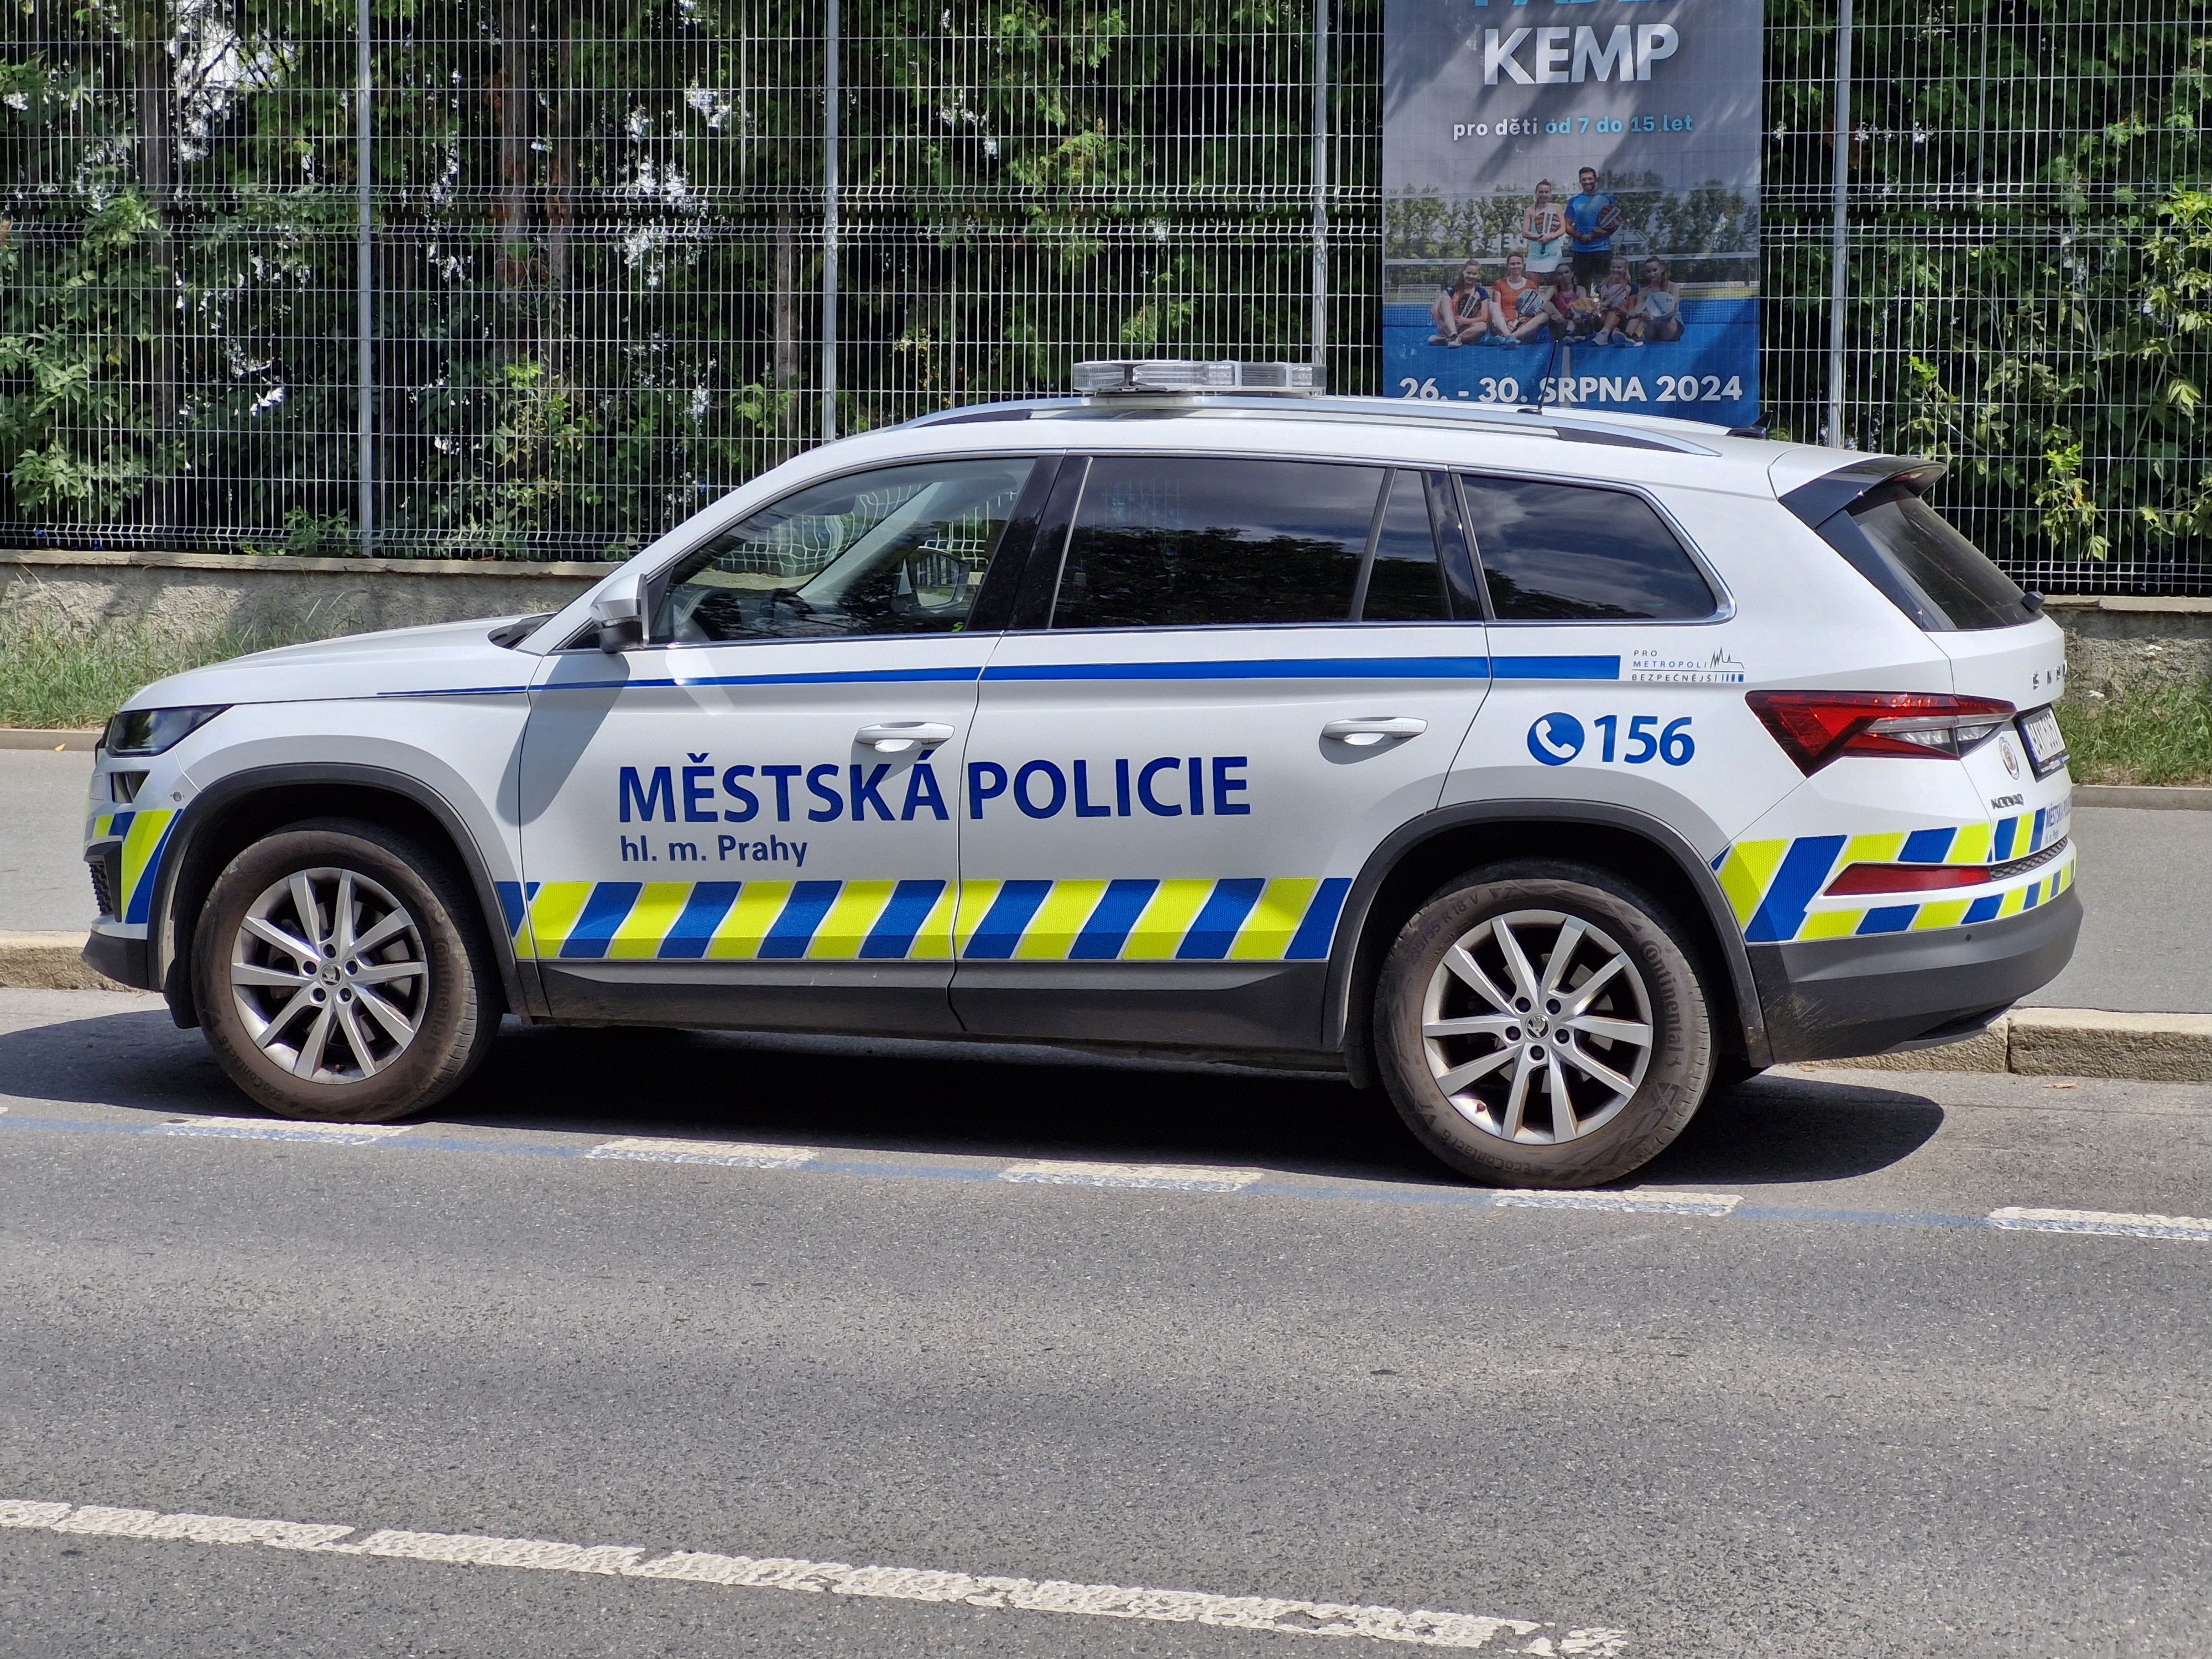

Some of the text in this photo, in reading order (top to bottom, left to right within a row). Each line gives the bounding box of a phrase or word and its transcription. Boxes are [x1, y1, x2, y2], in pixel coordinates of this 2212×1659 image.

[1484, 23, 1679, 85] KEMP
[1453, 114, 1693, 141] pro děti od 7 do 15 let
[1399, 377, 1448, 400] 26.
[1478, 377, 1528, 403] 30.
[1538, 375, 1647, 403] SRPNA
[1655, 375, 1744, 402] 2024
[1632, 660, 1708, 669] METROPOLI
[1633, 649, 1658, 658] PRO
[1593, 714, 1696, 766] 156
[618, 749, 1252, 823] MĚSTSKÁ POLICIE
[619, 834, 808, 869] hl. m. Prahy
[1640, 939, 1685, 1052] Continental
